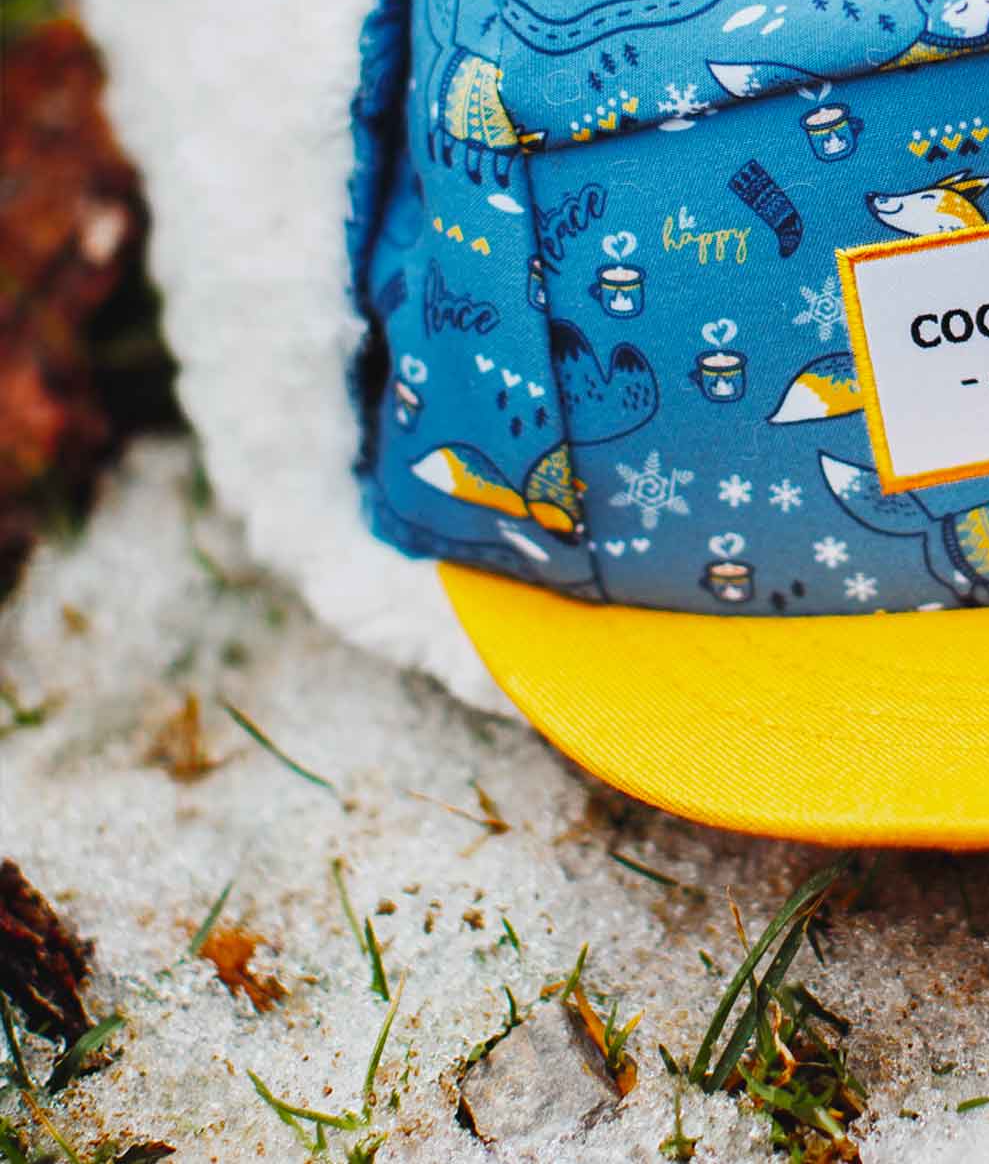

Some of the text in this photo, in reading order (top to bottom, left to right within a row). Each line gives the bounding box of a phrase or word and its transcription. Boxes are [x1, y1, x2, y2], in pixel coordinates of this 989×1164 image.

[533, 184, 608, 275] eace
[663, 216, 752, 265] happy
[679, 206, 697, 230] be
